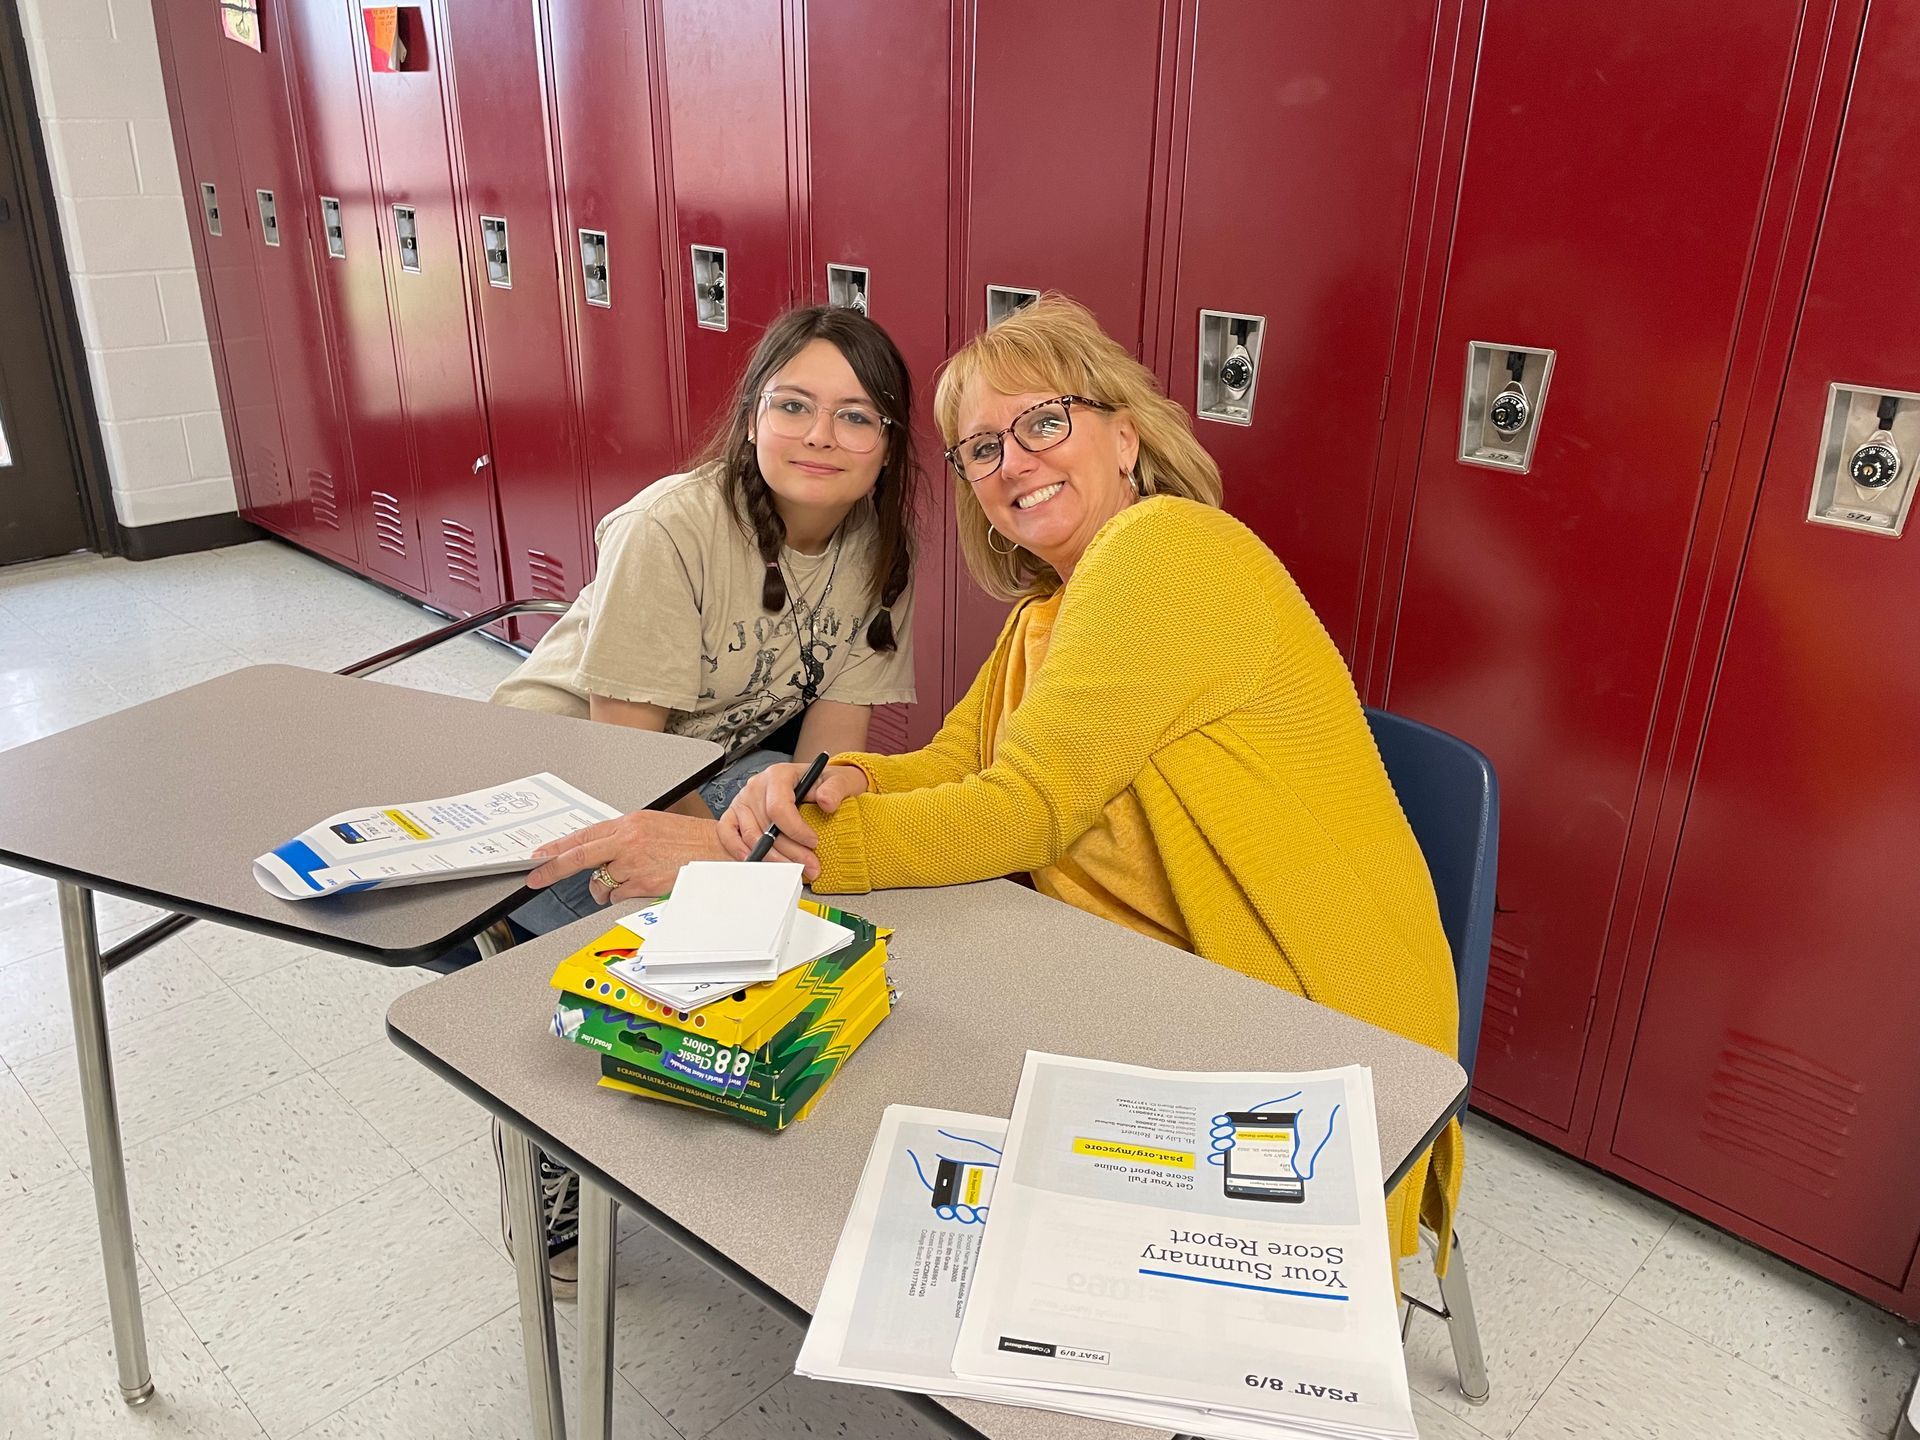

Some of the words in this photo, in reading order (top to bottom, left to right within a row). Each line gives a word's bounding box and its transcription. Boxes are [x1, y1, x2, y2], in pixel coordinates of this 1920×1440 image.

[1847, 513, 1871, 521] 574
[581, 1034, 594, 1043] Line
[594, 1038, 612, 1050] Broad
[682, 1037, 715, 1056] Colors
[670, 1059, 691, 1074] Washable
[676, 1049, 711, 1069] Classic
[714, 1049, 731, 1073] 8
[733, 1053, 750, 1076] 8
[692, 1069, 704, 1080] Most
[705, 1074, 723, 1083] World's
[621, 1067, 646, 1080] CRAYOLA
[647, 1074, 685, 1092] ULTRA-CLEAN
[685, 1088, 716, 1102] WASHABLE
[716, 1097, 739, 1109] CLASSIC
[739, 1104, 768, 1117] MARKERS
[1121, 1129, 1150, 1138] Reinert
[1084, 1144, 1184, 1163] psat.org/myscore
[1094, 1163, 1127, 1173] Online
[1130, 1167, 1163, 1177] Report
[1128, 1175, 1147, 1184] Full
[1150, 1178, 1174, 1188] Your
[1166, 1173, 1194, 1182] Score
[1170, 1229, 1258, 1257] Report
[1267, 1242, 1344, 1264] Score
[943, 1256, 951, 1271] Grade
[1140, 1243, 1272, 1281] Summary
[1281, 1266, 1347, 1289] Your
[958, 1282, 966, 1299] Middle
[955, 1300, 963, 1318] School
[1078, 1352, 1104, 1361] PSAT
[1245, 1375, 1283, 1391] 8/9
